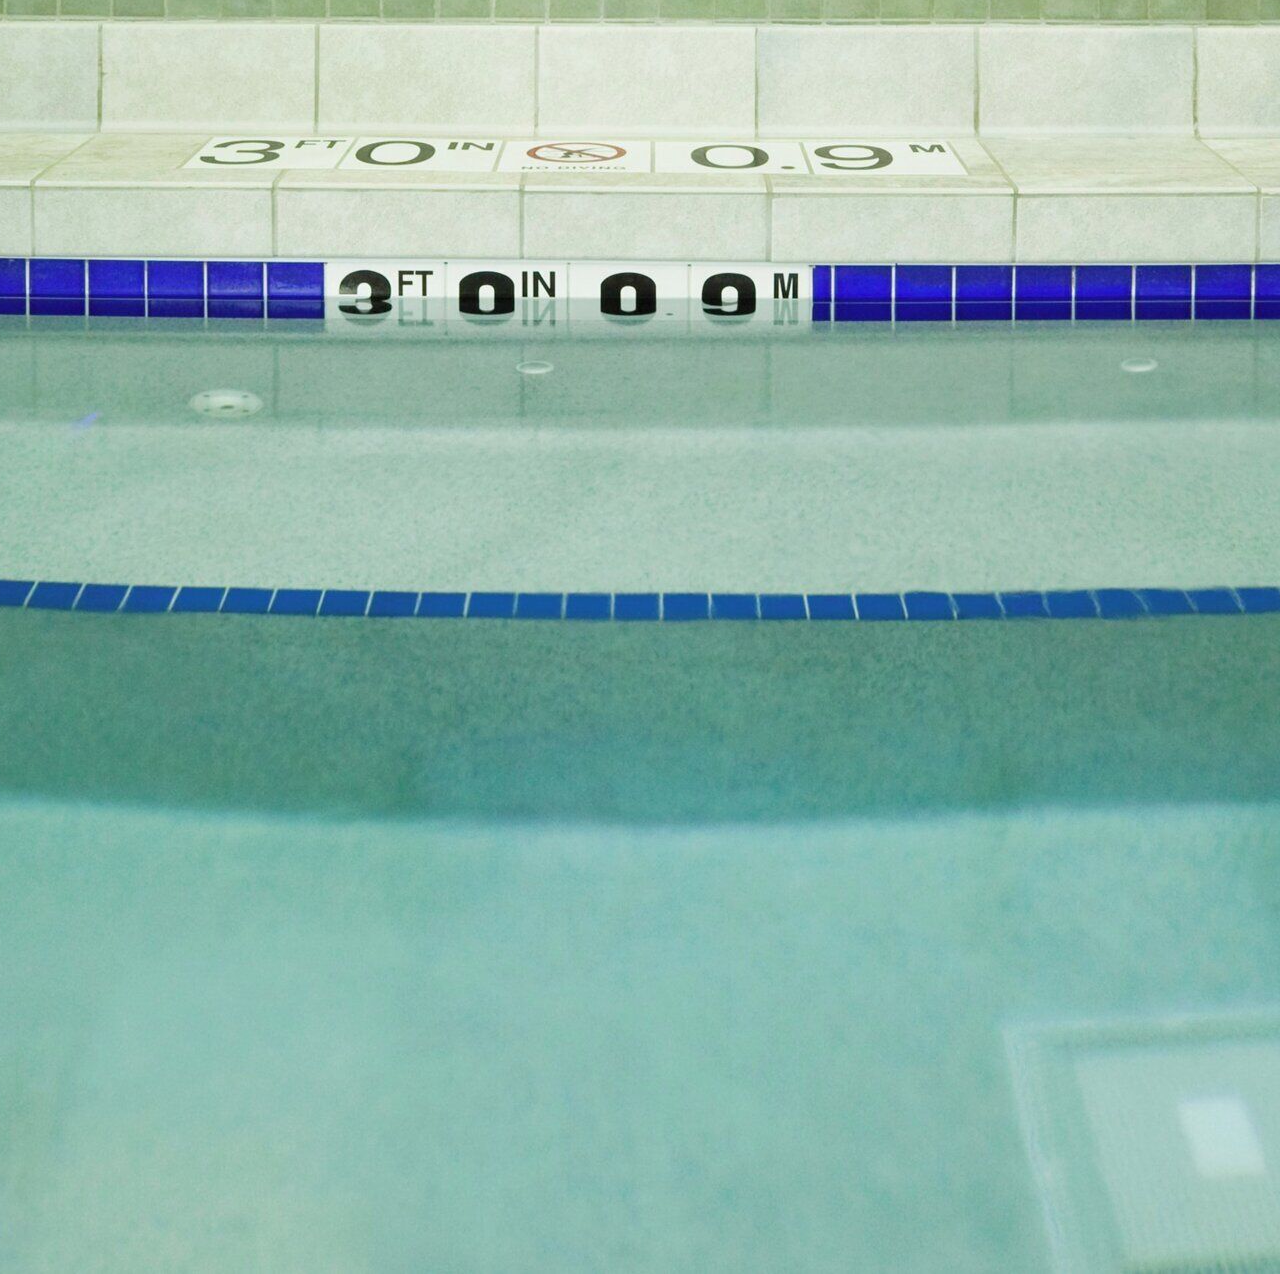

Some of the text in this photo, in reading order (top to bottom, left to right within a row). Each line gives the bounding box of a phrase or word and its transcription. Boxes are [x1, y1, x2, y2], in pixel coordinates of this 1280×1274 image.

[199, 139, 286, 165] 3
[294, 139, 346, 149] FT
[354, 140, 436, 166] 0
[446, 141, 495, 151] IN
[908, 143, 947, 153] M
[338, 269, 393, 315] 3
[397, 270, 434, 297] FT
[458, 270, 515, 316] 0
[521, 270, 556, 298] IN
[773, 272, 799, 299] M
